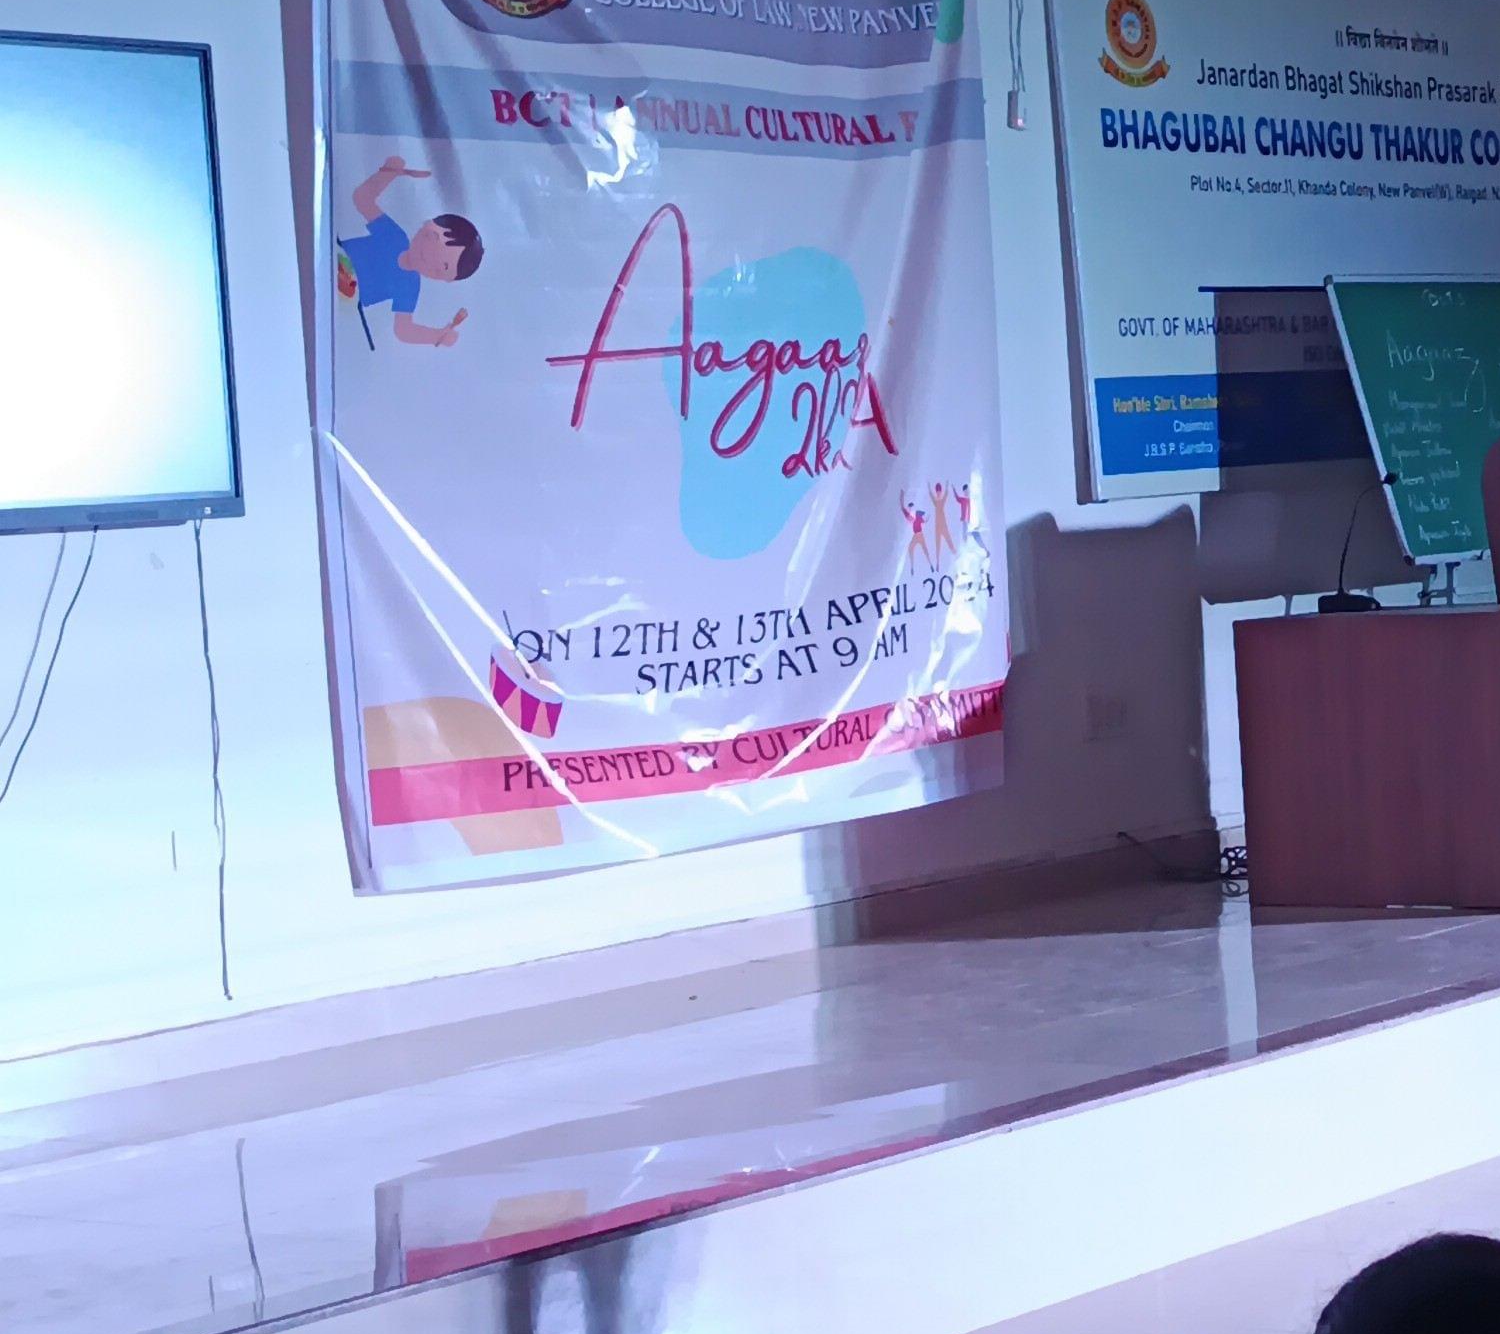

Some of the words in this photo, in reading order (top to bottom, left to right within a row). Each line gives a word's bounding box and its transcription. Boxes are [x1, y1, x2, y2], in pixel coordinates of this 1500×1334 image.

[849, 1, 941, 36] PANVE
[1197, 58, 1279, 89] Janardan
[1284, 65, 1343, 100] Bhagat
[1349, 70, 1422, 100] Shikshan
[1427, 76, 1497, 104] Prasarak
[613, 95, 740, 138] NNUAL
[745, 105, 897, 146] CULTURAL
[1100, 108, 1246, 154] BHAGUBAI
[1255, 116, 1364, 160] CHANGU
[1370, 123, 1465, 165] THAKUR
[1190, 174, 1214, 193] Plot
[1378, 182, 1401, 198] New
[1118, 317, 1159, 337] GOVT.
[1163, 317, 1180, 336] OF
[1185, 315, 1285, 336] MAHARASHTRA
[593, 619, 679, 659] 12TH
[692, 617, 720, 650] &
[736, 605, 811, 646] 13TH
[636, 653, 763, 696] STARTS
[777, 642, 819, 680] AT
[832, 636, 859, 668] 9
[873, 623, 909, 661] AM
